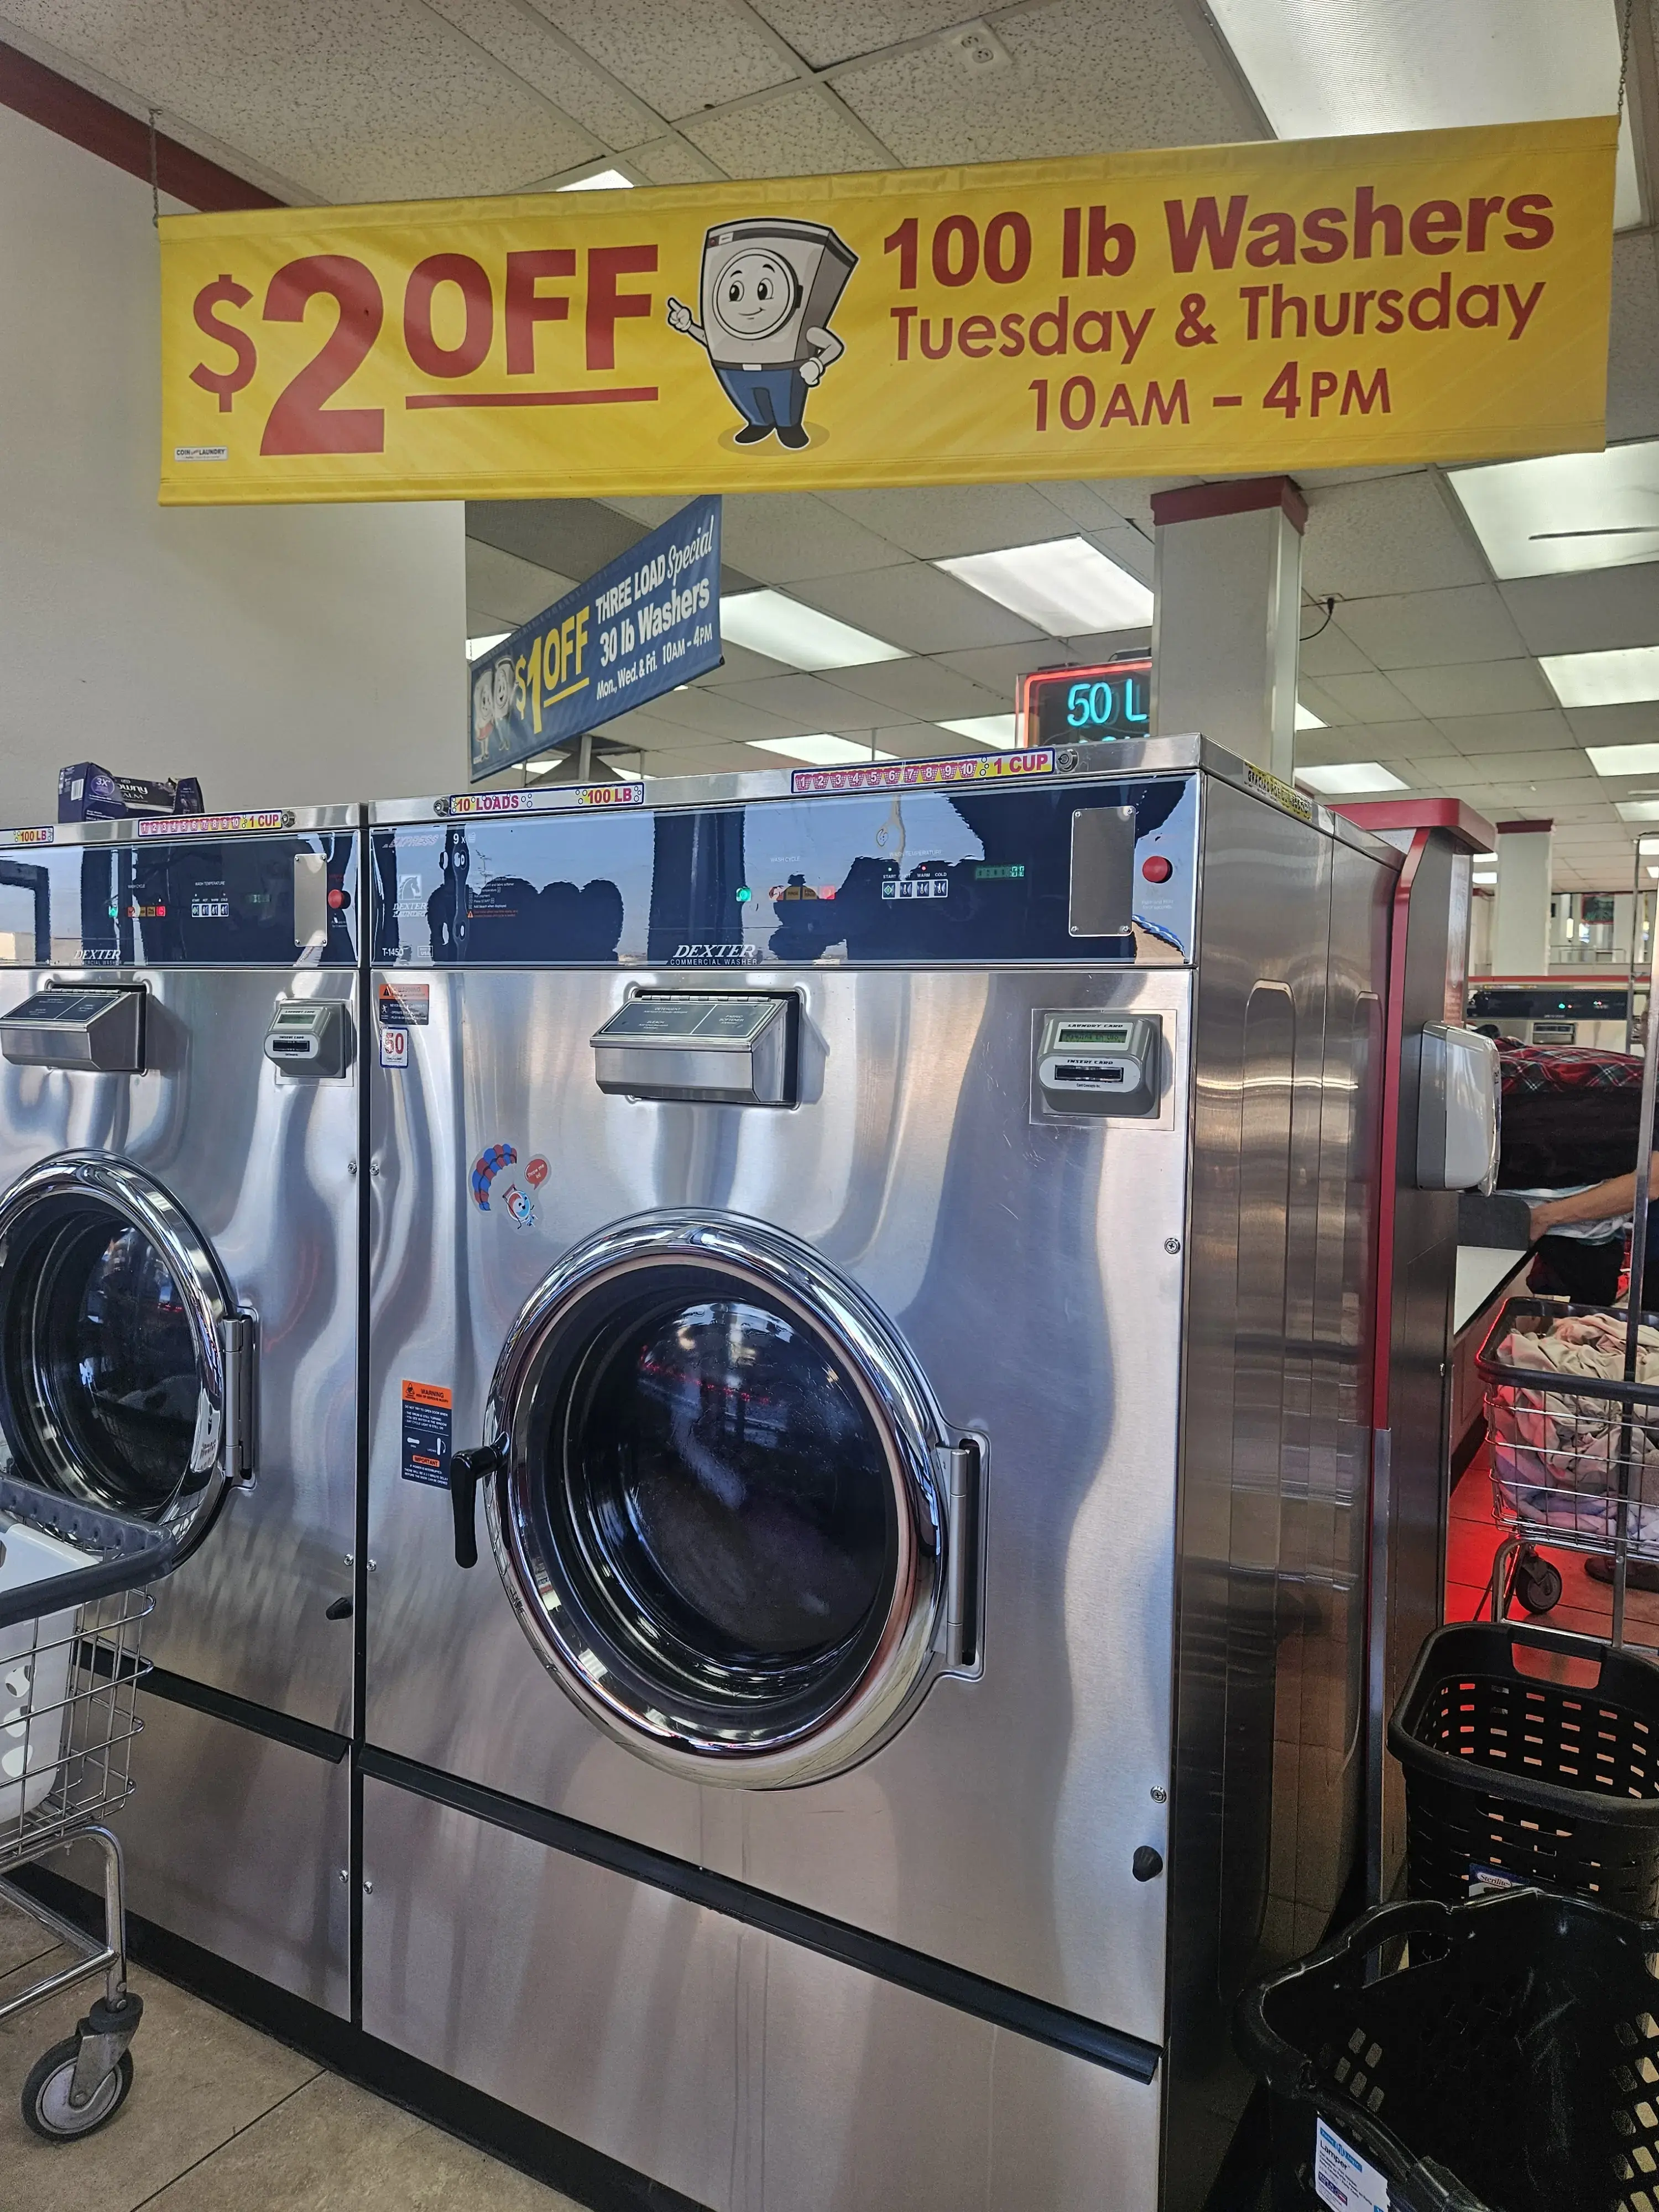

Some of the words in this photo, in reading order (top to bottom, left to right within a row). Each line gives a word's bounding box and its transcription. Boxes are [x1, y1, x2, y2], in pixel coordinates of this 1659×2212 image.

[884, 211, 1031, 290] 100
[1062, 205, 1135, 278] lb
[1164, 186, 1554, 273] Washers
[890, 296, 1155, 364] Tuesday
[1175, 293, 1218, 347] &
[1239, 272, 1546, 340] Thursday
[189, 254, 384, 456] $2
[404, 244, 658, 378] OFF
[1029, 375, 1190, 431] 10AM
[1263, 361, 1391, 419] 4PM
[596, 576, 632, 624] THREE
[635, 554, 665, 601] LOAD
[667, 515, 714, 586] Special
[600, 626, 617, 667] 30
[621, 618, 634, 656] lb
[638, 578, 709, 645] Washers
[515, 636, 542, 734] $1
[543, 606, 589, 691] OFF
[597, 679, 617, 700] Mon.,
[618, 661, 638, 688] Wed.
[639, 658, 645, 678] &
[646, 650, 658, 674] Fri.
[663, 638, 685, 665] 10AM
[693, 623, 712, 648] 4PM
[1067, 682, 1112, 726] 50
[801, 777, 805, 786] 1
[818, 776, 824, 786] 2
[836, 775, 841, 785] 3
[853, 773, 859, 783] 4
[870, 772, 877, 782] 5
[889, 770, 895, 780] 6
[907, 769, 914, 779] 7
[926, 767, 932, 778] 8
[945, 765, 952, 776] 9
[961, 763, 972, 774] 10
[994, 758, 1002, 774] 1
[1009, 754, 1048, 773] CUP
[457, 799, 470, 812] 10
[476, 795, 519, 811] LOADS
[588, 790, 609, 804] 100
[614, 788, 632, 802] LB
[249, 816, 254, 827] 1
[258, 814, 279, 826] CUP
[20, 831, 34, 842] 100
[36, 830, 46, 841] LB
[389, 834, 439, 847] EXPRESS
[453, 833, 459, 844] 9
[74, 950, 121, 959] DEXTER
[673, 945, 755, 958] DEXTER
[421, 1389, 444, 1398] WARNING
[415, 1457, 437, 1466] IMPORTANT
[1480, 1875, 1510, 1886] Sterilite
